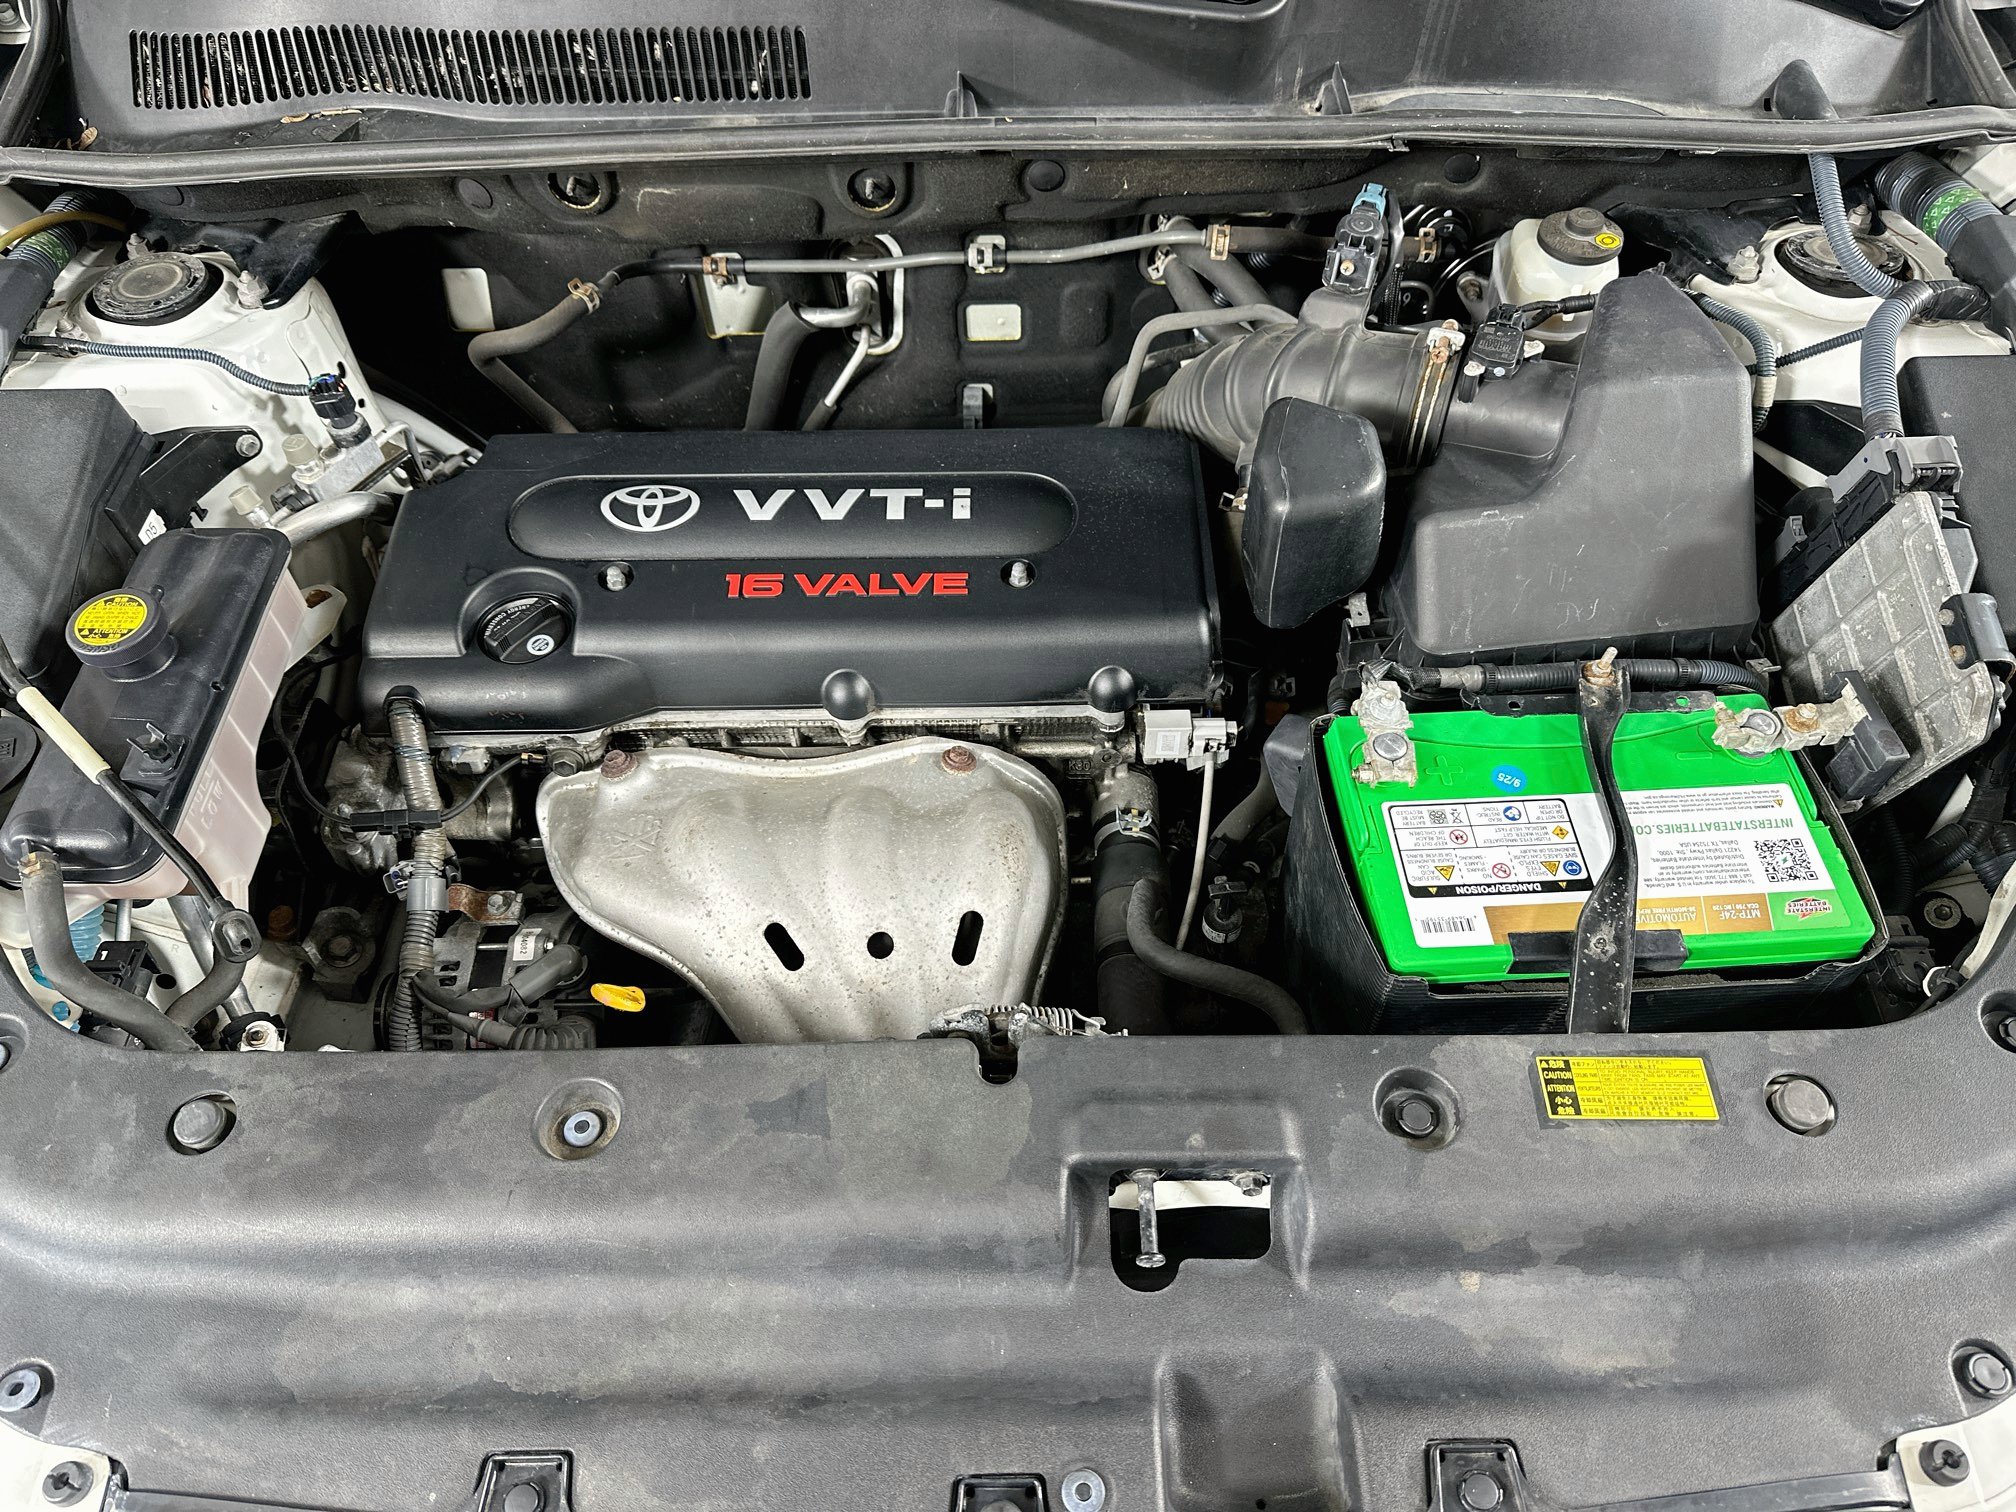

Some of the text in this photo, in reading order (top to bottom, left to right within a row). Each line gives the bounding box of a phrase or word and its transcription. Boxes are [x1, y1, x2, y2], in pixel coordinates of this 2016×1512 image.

[733, 488, 971, 520] VVT-i
[726, 572, 969, 598] 16 VALVE
[1497, 772, 1521, 788] 9/25
[1632, 818, 1793, 835] INTERSTATEBATTERIES.CO
[1455, 882, 1542, 894] DANGER/POISON
[1636, 913, 1696, 923] AUTOMOTIVE
[1720, 909, 1761, 920] MTP-24F
[101, 950, 108, 960] 1
[1544, 1071, 1572, 1079] CAUTION
